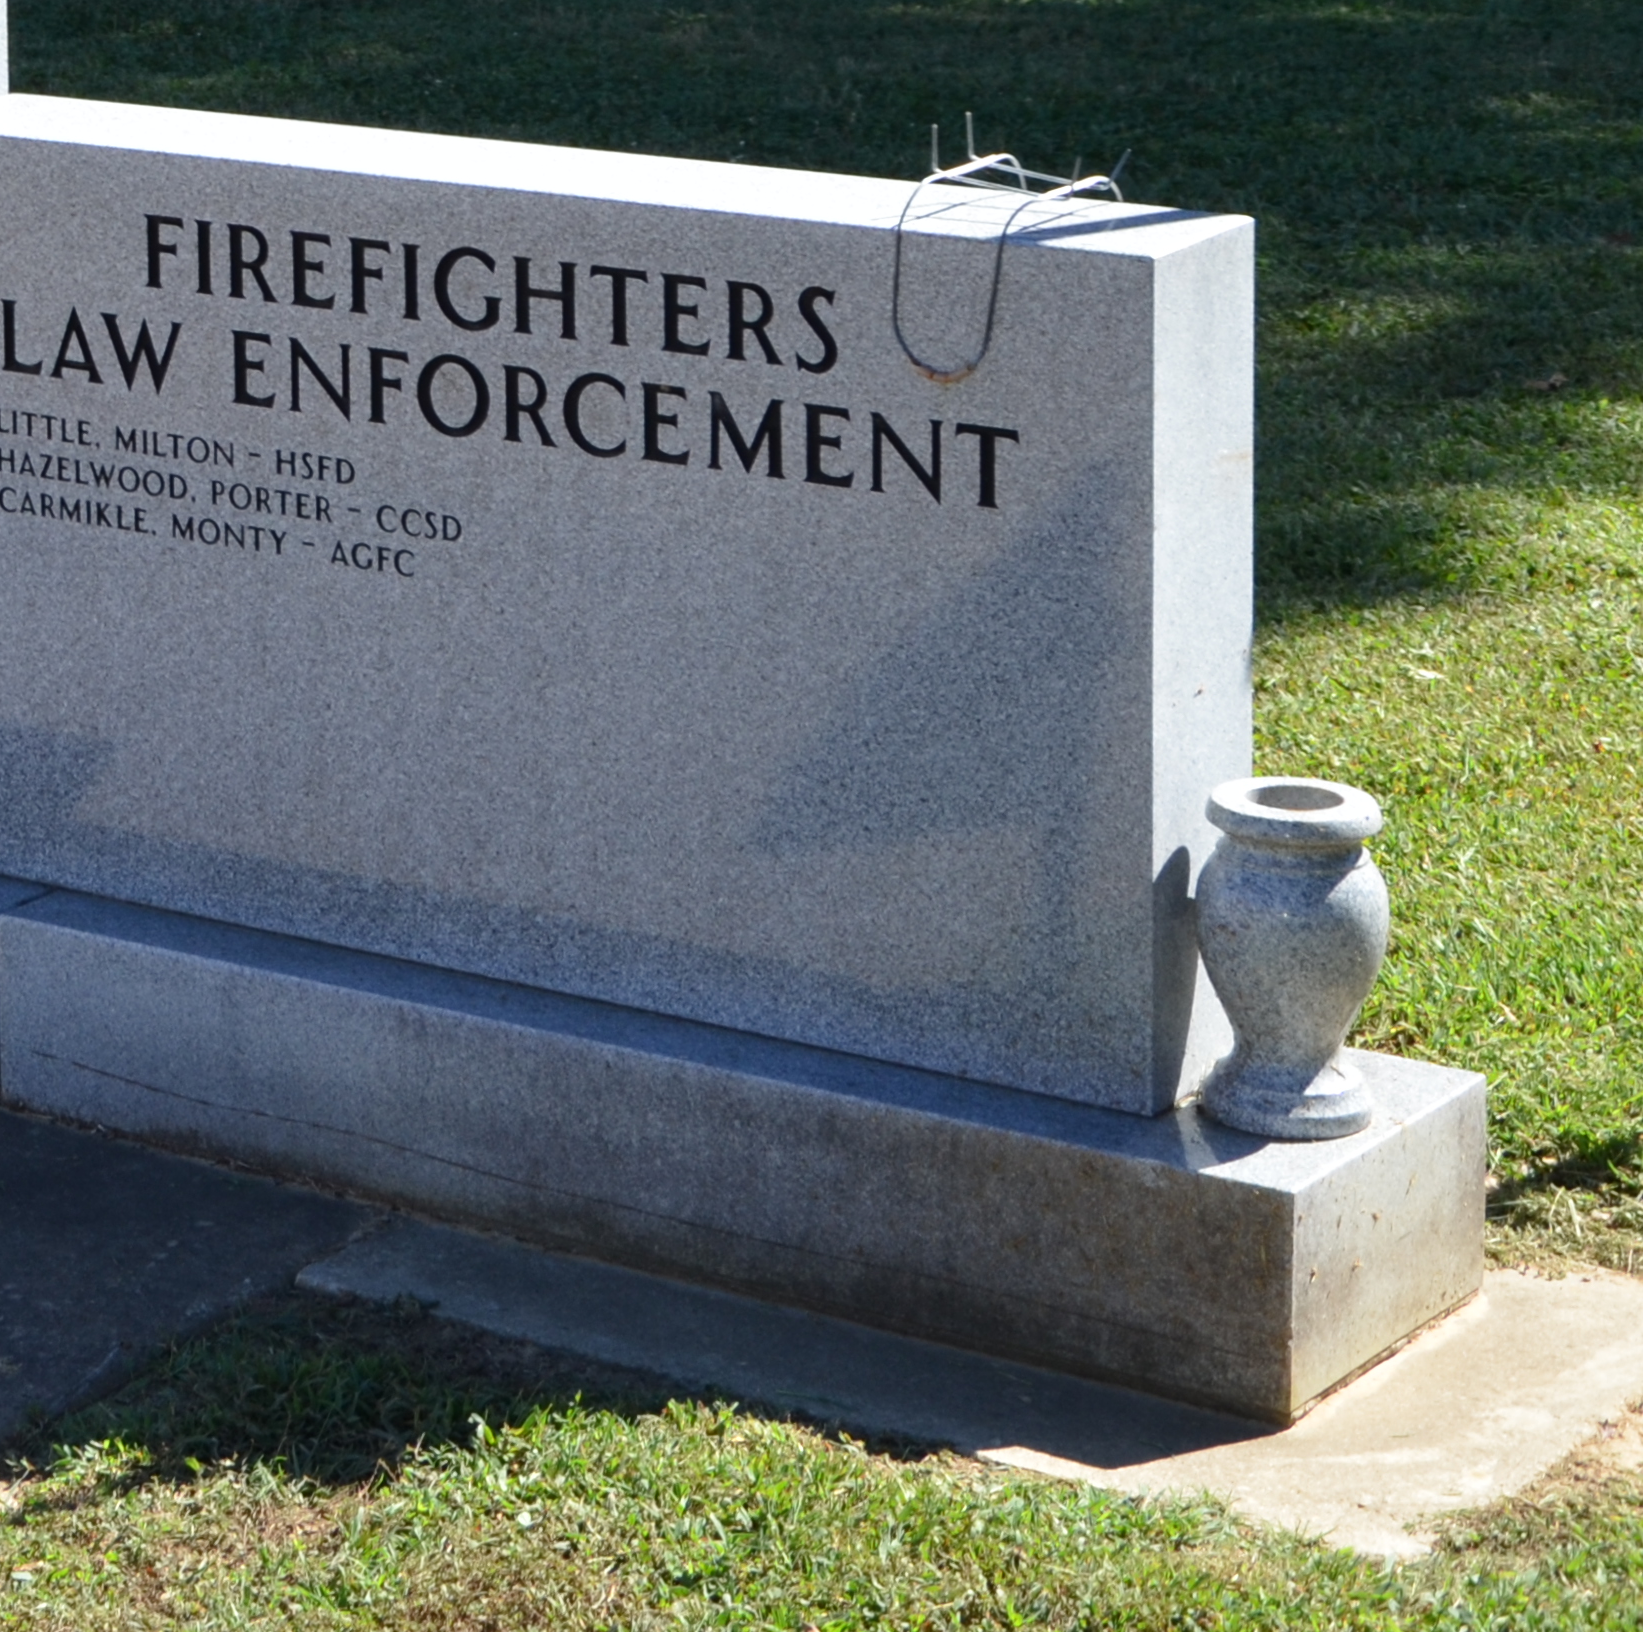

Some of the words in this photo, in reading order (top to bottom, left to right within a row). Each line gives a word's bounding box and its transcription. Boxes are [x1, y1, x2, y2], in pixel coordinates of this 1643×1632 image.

[143, 213, 839, 374] FIREFIGHTERS
[230, 330, 1020, 509] ENFORCEMENT
[114, 426, 234, 466] MILTON
[275, 449, 355, 484] HSFD
[211, 480, 331, 522] PORTER
[375, 504, 462, 541] CCSD
[172, 513, 286, 554] MONTY
[330, 540, 414, 577] AGFC
